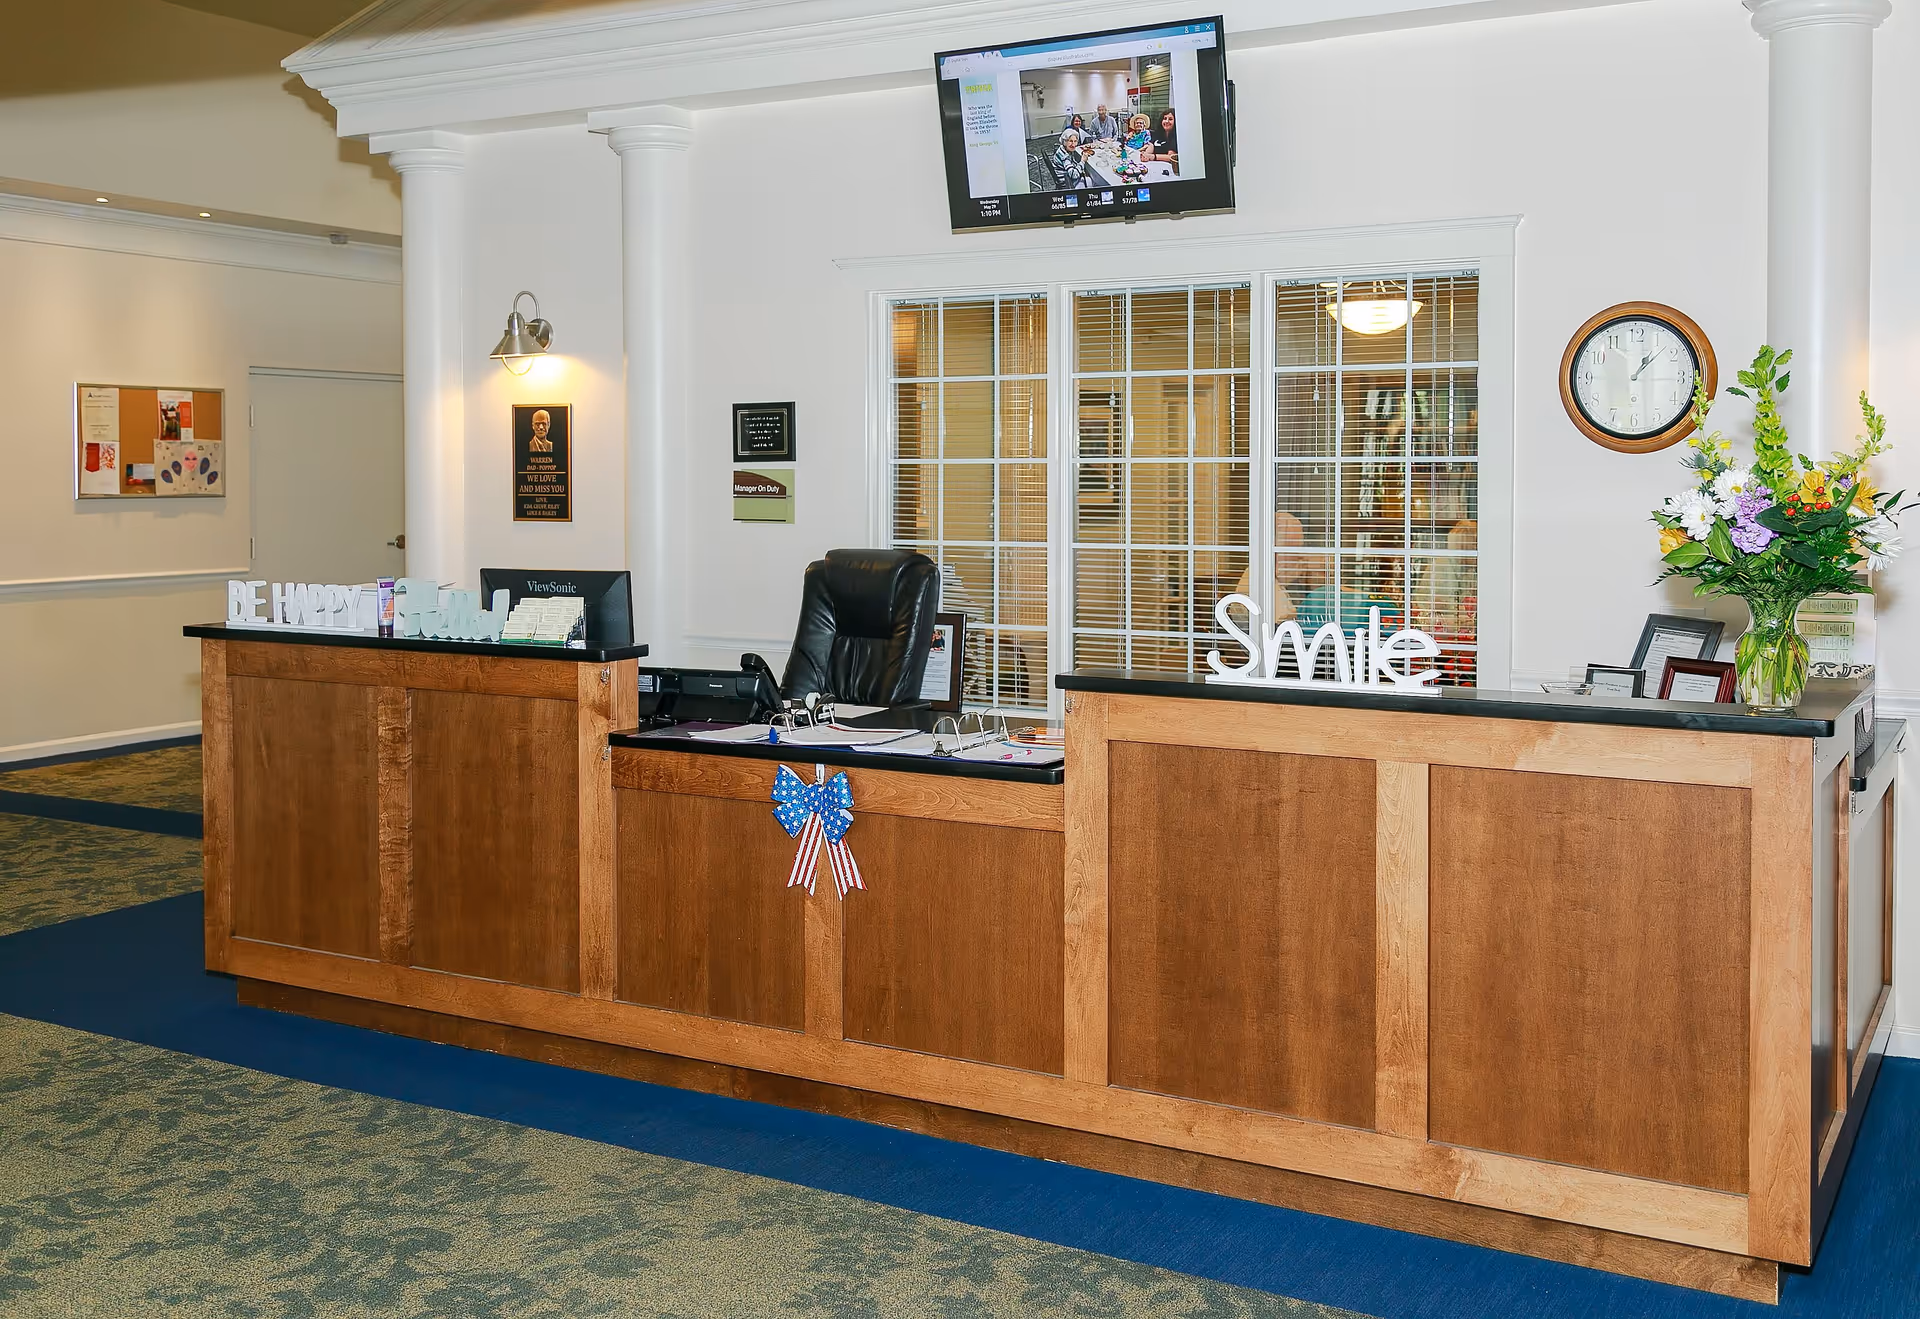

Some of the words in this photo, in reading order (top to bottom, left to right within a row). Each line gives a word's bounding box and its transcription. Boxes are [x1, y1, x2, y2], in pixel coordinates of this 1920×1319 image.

[1608, 335, 1619, 349] 11
[1630, 328, 1644, 342] 12
[1654, 333, 1659, 346] 1
[1592, 351, 1605, 364] 10
[1670, 349, 1678, 362] 2
[1585, 371, 1593, 384] 9
[1677, 370, 1685, 384] 3
[1592, 393, 1599, 406] 8
[1669, 391, 1678, 405] 4
[1609, 408, 1617, 422] 7
[1630, 413, 1638, 427] 6
[1653, 408, 1661, 422] 5
[735, 485, 757, 493] Manager
[767, 485, 779, 494] Duty
[527, 580, 576, 593] ViewSonic
[228, 580, 268, 622] BE
[272, 582, 362, 628] HAPPY
[1206, 594, 1442, 688] Smile
